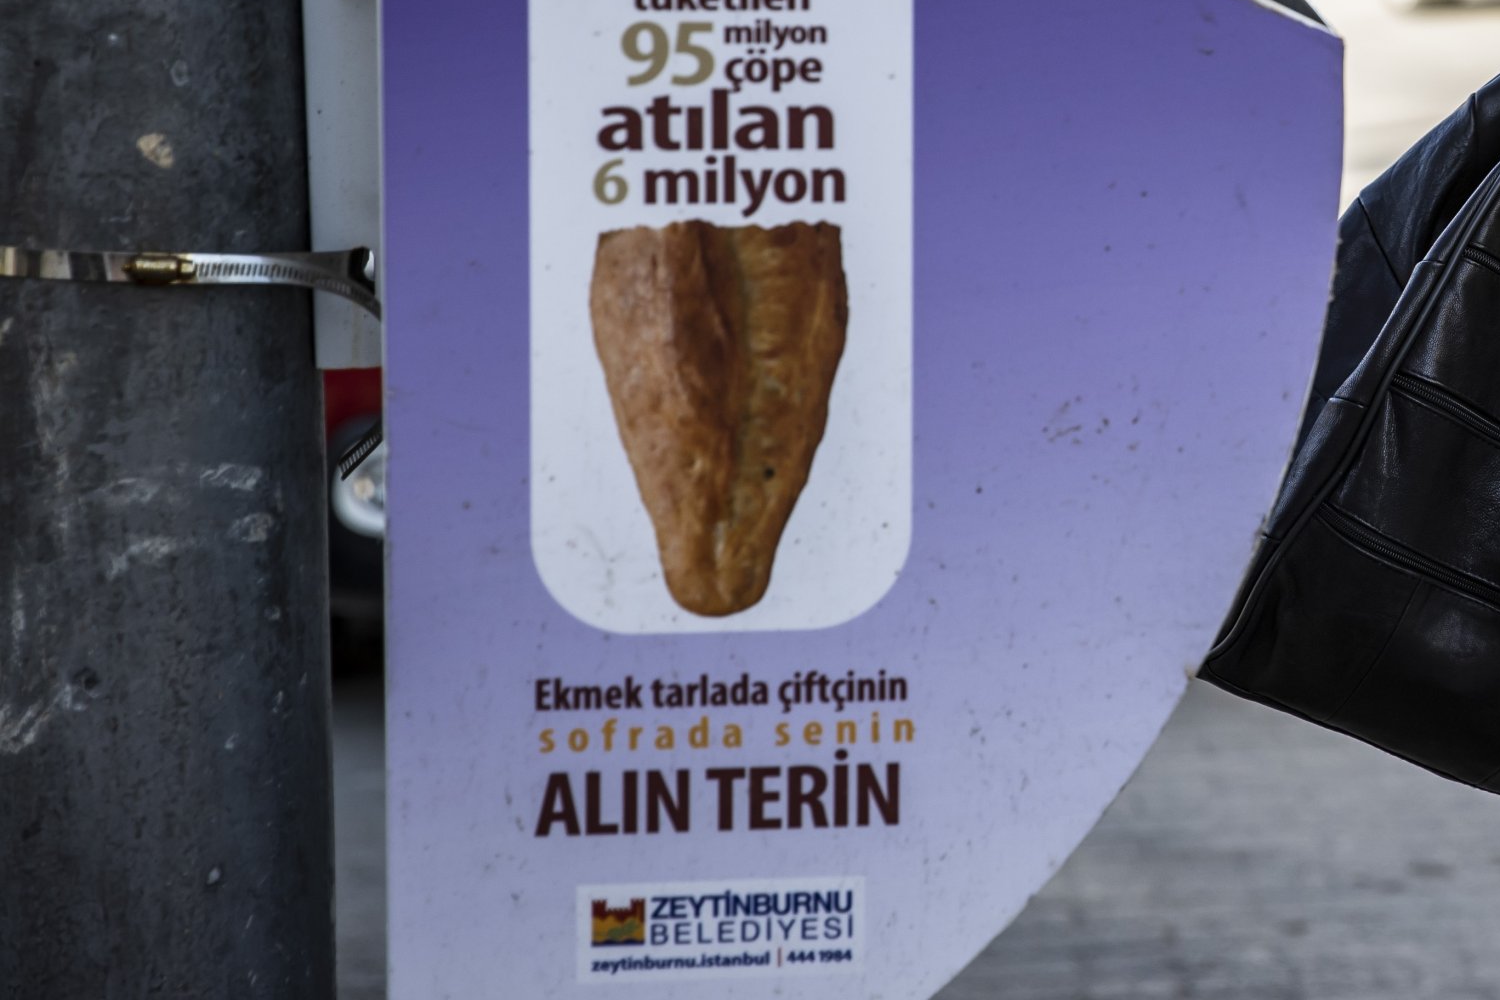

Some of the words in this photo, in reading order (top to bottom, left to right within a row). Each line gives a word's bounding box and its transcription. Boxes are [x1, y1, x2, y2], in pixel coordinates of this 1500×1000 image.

[620, 20, 717, 88] 95
[723, 18, 828, 51] milyon
[723, 49, 823, 93] çöpe
[596, 87, 835, 152] atılan
[592, 157, 629, 206] 6
[643, 154, 846, 219] milyon
[534, 675, 643, 712] Ekmek
[650, 672, 769, 709] tarlada
[777, 669, 908, 714] çiftçinin
[538, 716, 743, 754] sofrada
[774, 711, 916, 748] senin
[534, 768, 691, 838] ALIN
[705, 748, 901, 832] TERİN
[650, 889, 853, 920] ZEYTİNBURNU
[650, 914, 854, 946] BELEDİYESİ
[591, 950, 771, 975] zeytinburnu.istanbul
[786, 950, 816, 963] 444
[818, 949, 853, 963] 1984
